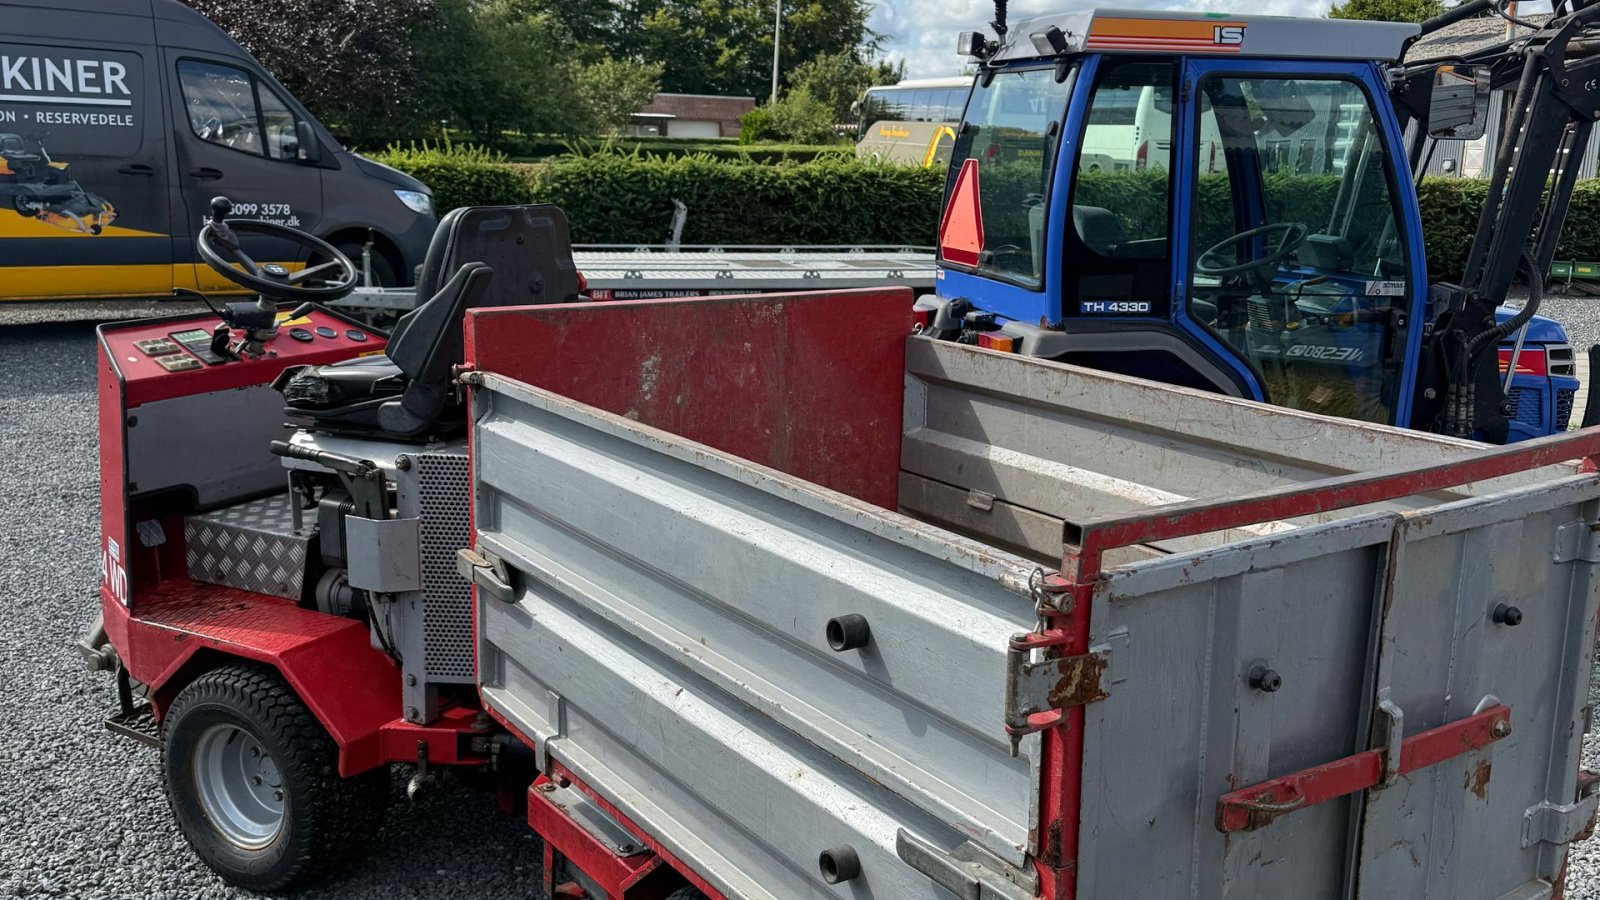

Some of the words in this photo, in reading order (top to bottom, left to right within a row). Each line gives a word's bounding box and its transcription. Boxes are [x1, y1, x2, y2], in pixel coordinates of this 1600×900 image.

[1, 55, 131, 95] KINER
[36, 111, 134, 126] RESERVEDELE
[261, 203, 291, 215] 3578
[614, 290, 637, 298] BRIAN
[639, 290, 663, 298] JAMES
[665, 290, 700, 298] TRAILERS
[1084, 302, 1104, 312] TH
[1108, 302, 1149, 312] 4330
[102, 550, 127, 606] 4WD
